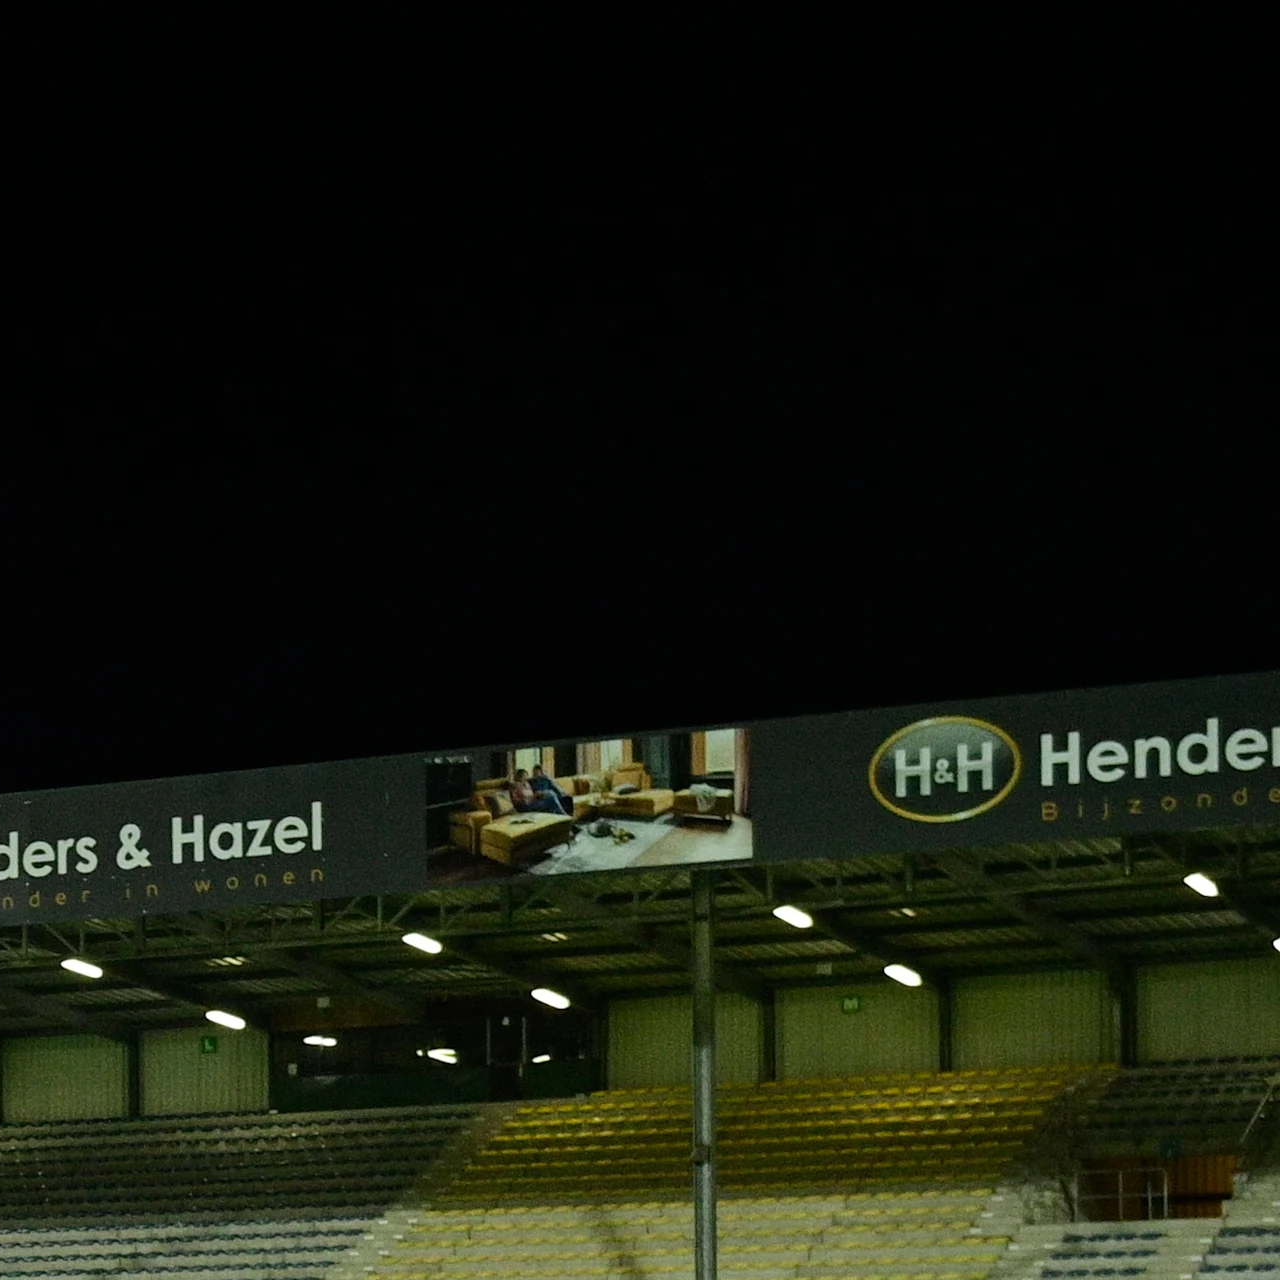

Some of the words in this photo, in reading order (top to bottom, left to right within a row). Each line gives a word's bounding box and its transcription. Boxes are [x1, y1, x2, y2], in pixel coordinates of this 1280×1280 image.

[895, 740, 994, 798] H&H
[116, 823, 151, 869] &
[171, 801, 323, 864] Hazel
[125, 883, 158, 901] in
[195, 867, 324, 894] wonen
